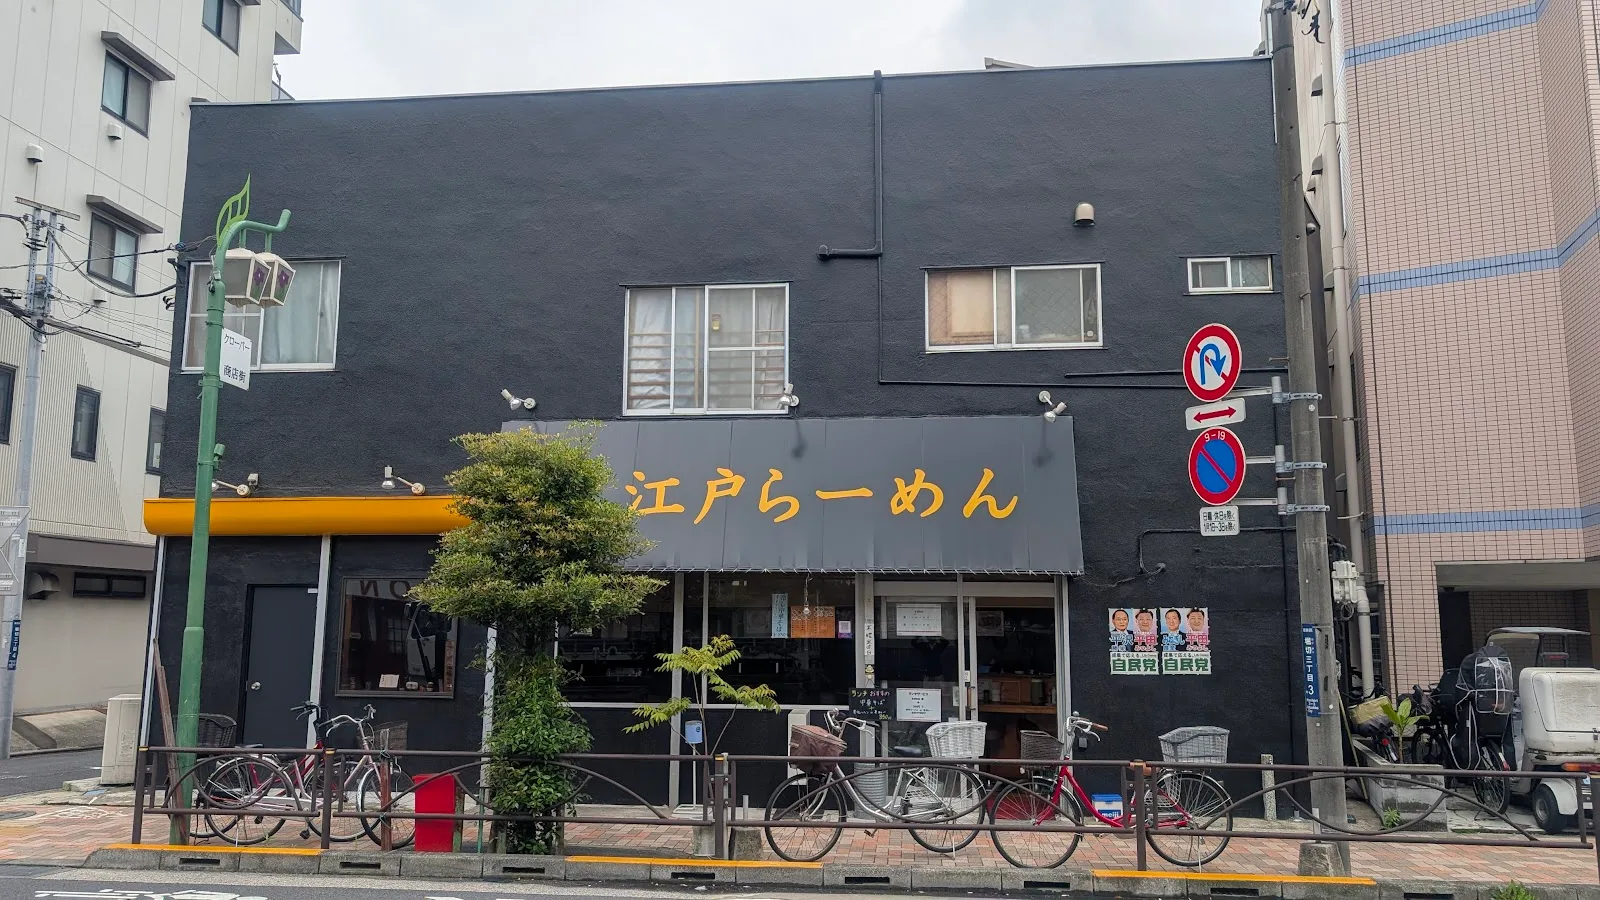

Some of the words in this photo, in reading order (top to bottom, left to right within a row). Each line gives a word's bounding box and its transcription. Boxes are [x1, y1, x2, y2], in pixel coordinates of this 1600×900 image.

[224, 333, 250, 351] クローバー
[223, 364, 246, 383] 商店街
[1204, 430, 1226, 443] 9-19
[625, 467, 1018, 525] 江戸らーめん
[1112, 658, 1157, 671] 自民党
[1164, 658, 1209, 671] 自民党
[1308, 685, 1314, 695] 3
